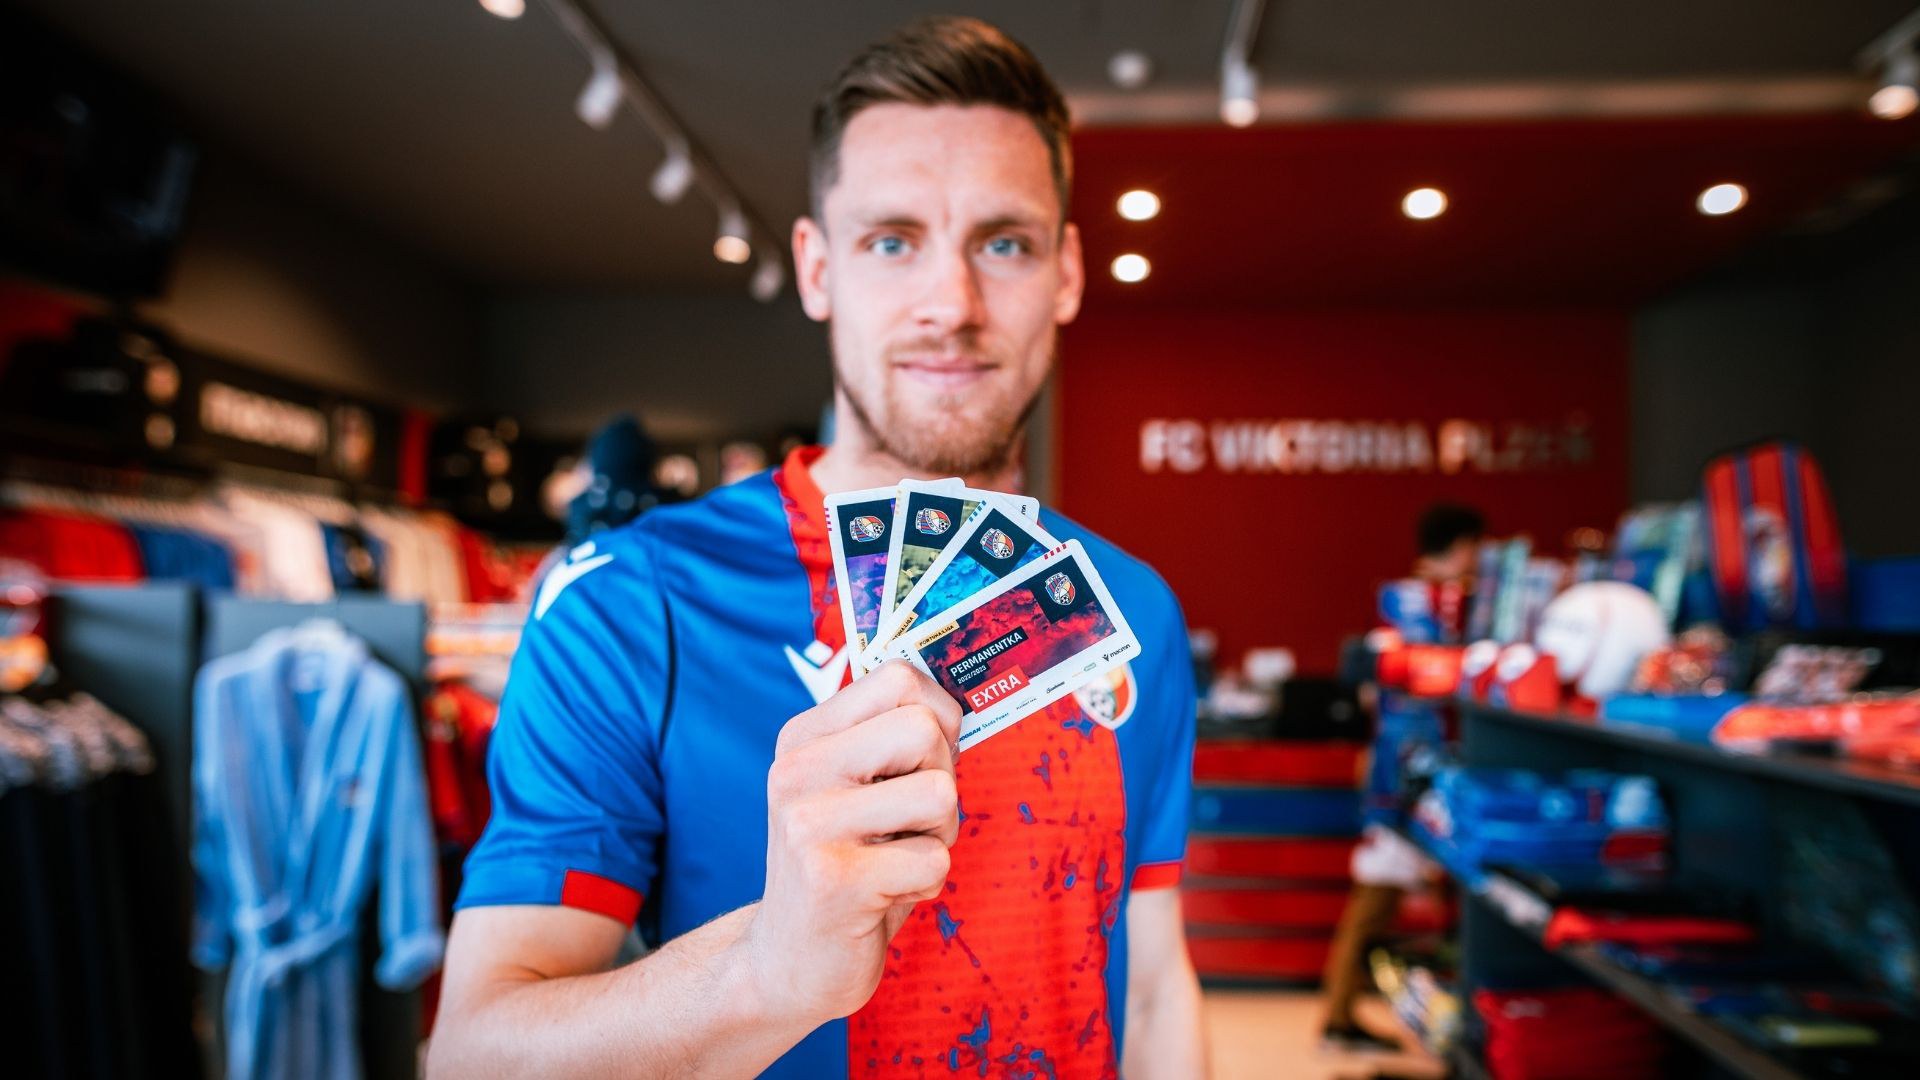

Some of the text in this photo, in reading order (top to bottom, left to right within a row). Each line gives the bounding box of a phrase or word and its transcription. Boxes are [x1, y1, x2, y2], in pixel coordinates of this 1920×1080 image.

[1140, 420, 1202, 472] FC
[950, 632, 1023, 677] PERMANENTKA
[1109, 643, 1131, 658] macron
[957, 664, 987, 685] 2022/2023
[971, 673, 1022, 708] EXTRA
